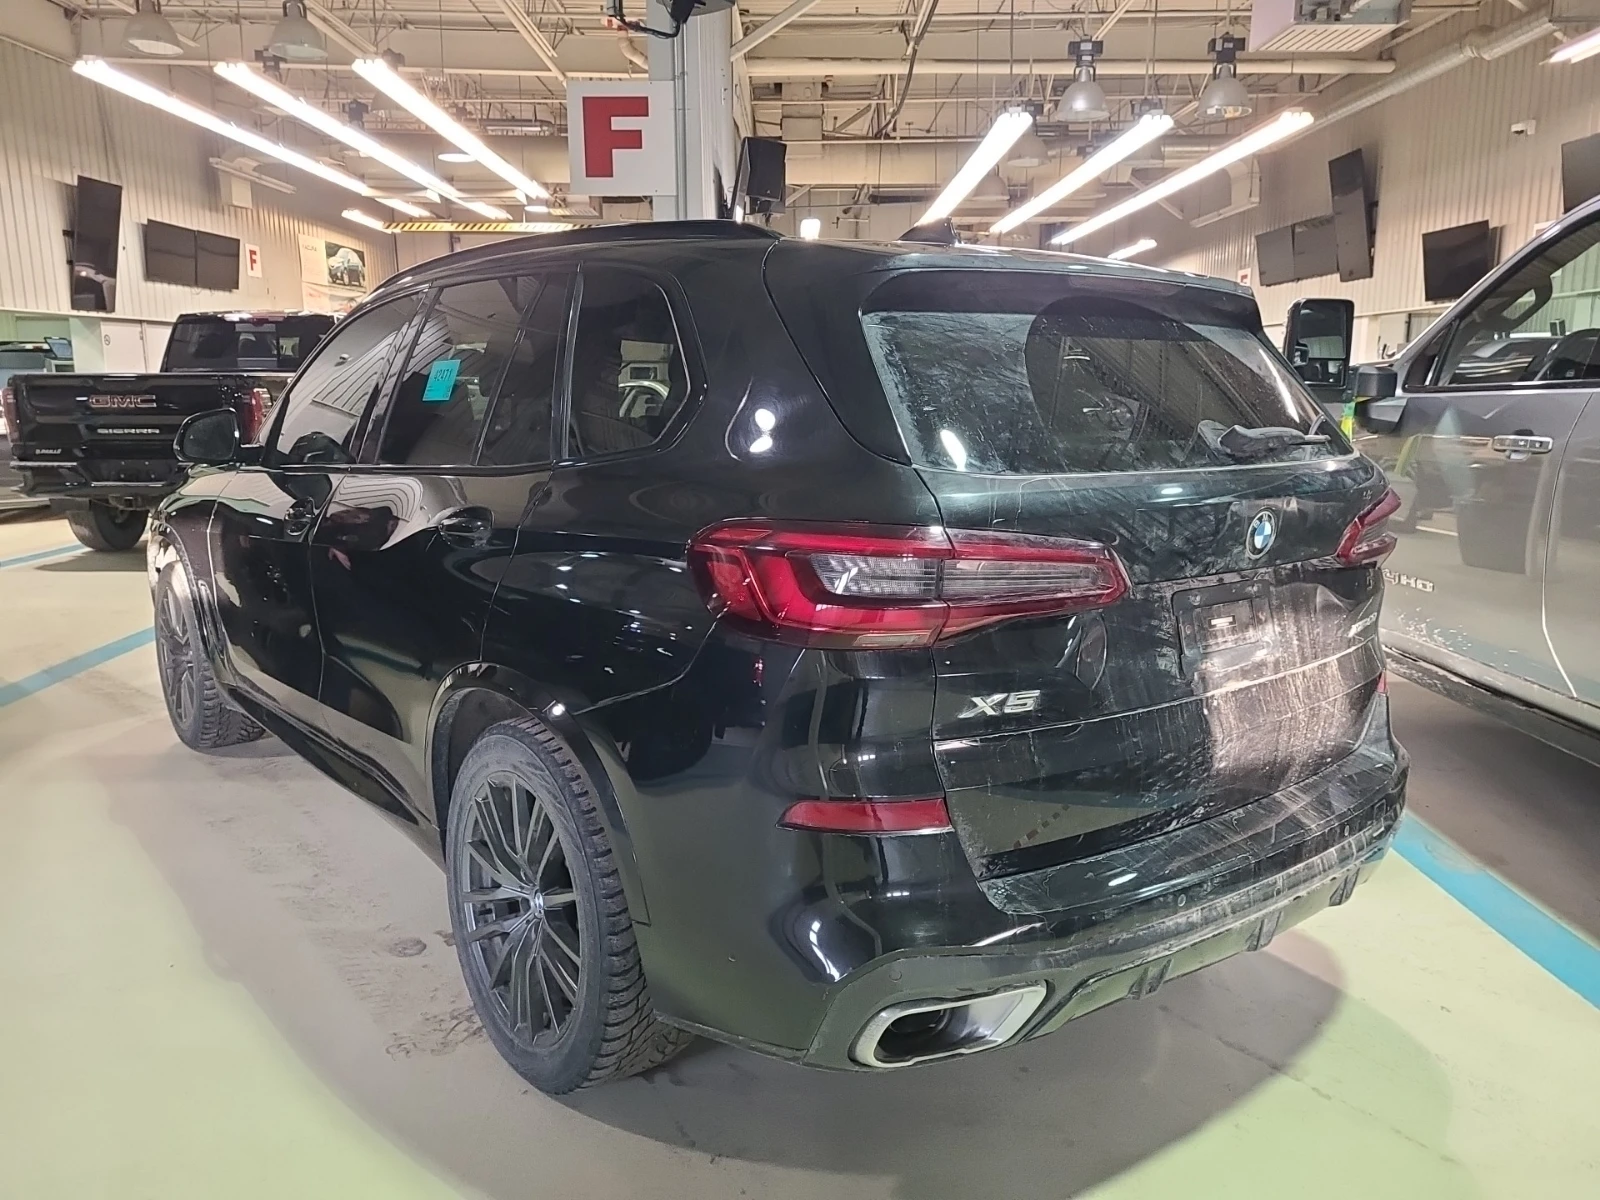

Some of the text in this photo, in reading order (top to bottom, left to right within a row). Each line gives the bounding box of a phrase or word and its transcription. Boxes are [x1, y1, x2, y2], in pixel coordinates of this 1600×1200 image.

[582, 96, 649, 178] F
[248, 249, 257, 271] F
[89, 394, 157, 408] GMC
[957, 690, 1041, 719] X5
